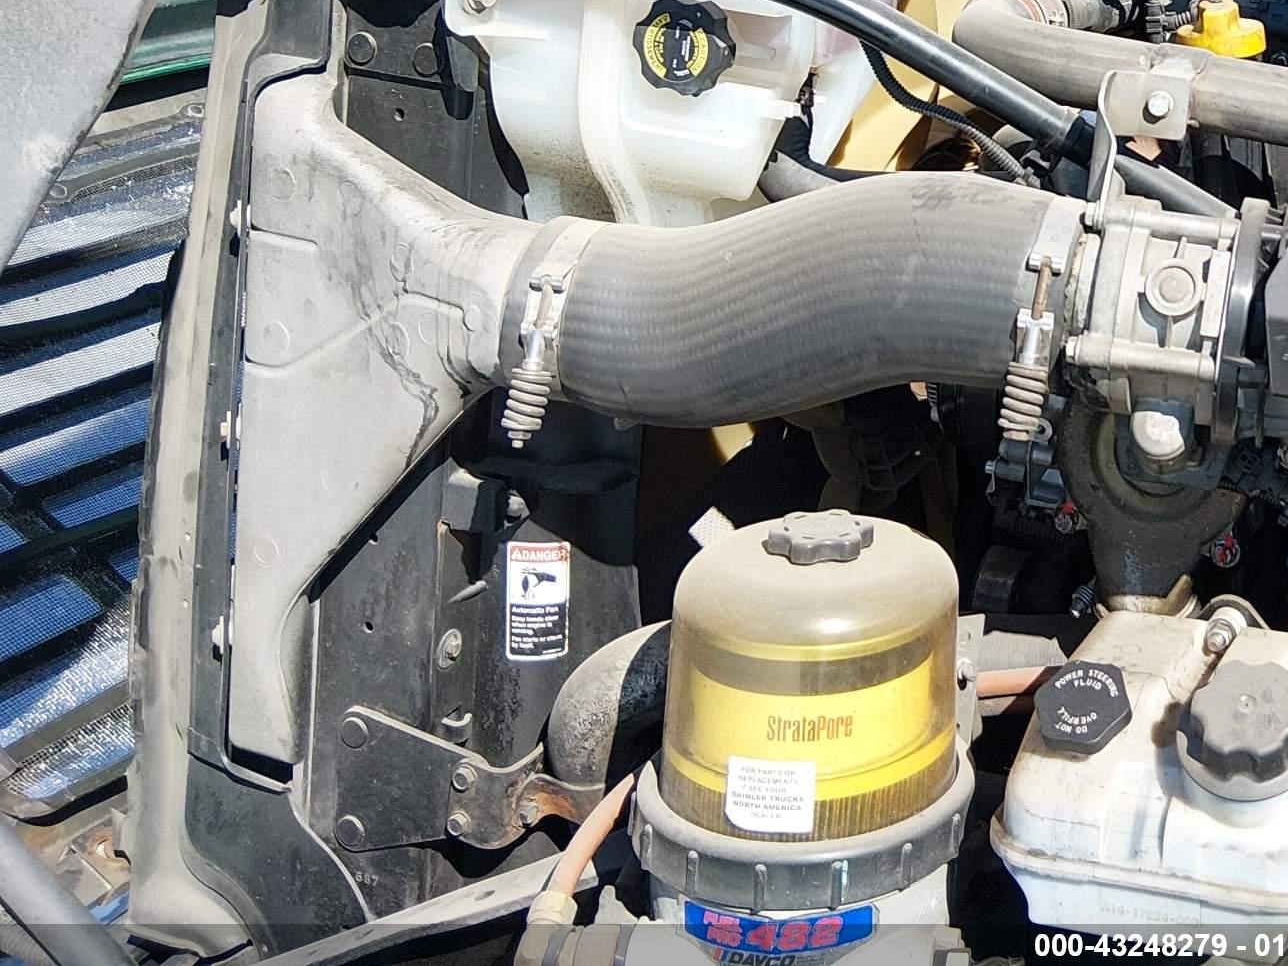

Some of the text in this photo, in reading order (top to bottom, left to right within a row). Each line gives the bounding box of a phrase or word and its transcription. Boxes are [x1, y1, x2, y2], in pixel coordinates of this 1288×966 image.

[522, 549, 567, 562] DANGER
[512, 606, 545, 614] Automatic
[1054, 669, 1119, 698] POWER STEERING
[1073, 678, 1102, 690] FLUID
[1057, 706, 1098, 725] OVERFILL
[766, 714, 854, 743] StrataPore
[1054, 722, 1088, 735] DO NOT
[757, 768, 783, 776] PARTS
[738, 775, 798, 785] REPLACEMENTS
[731, 790, 804, 803] DAIMLER TRUCKS
[765, 786, 787, 794] YOUR
[733, 800, 761, 809] NORTH
[703, 910, 844, 953] FUEL 482
[706, 927, 743, 948] PRO
[727, 952, 796, 966] DAYCO
